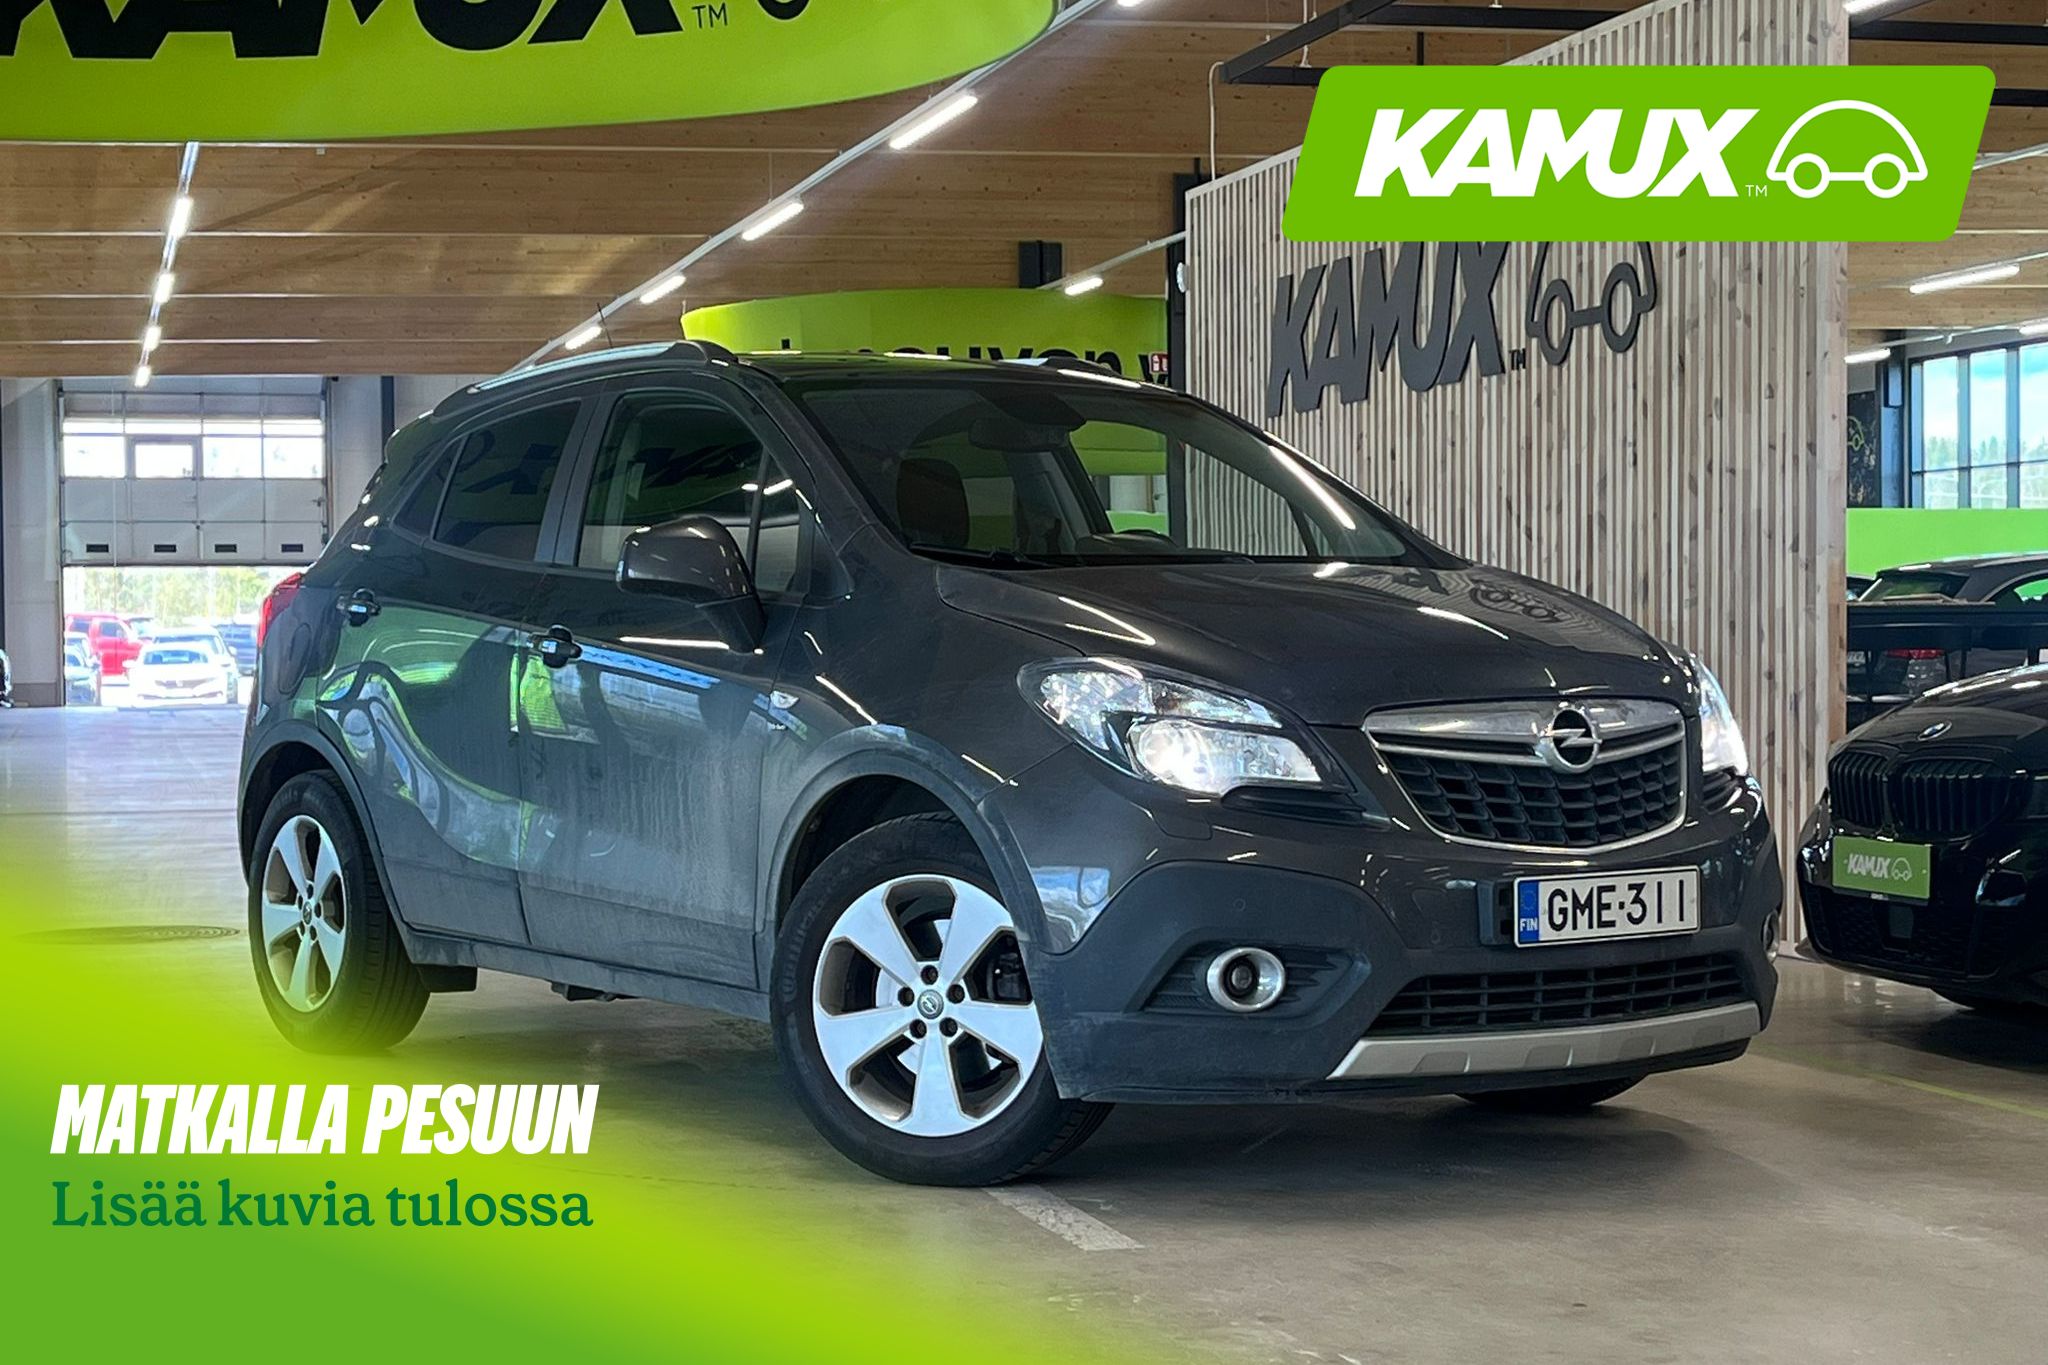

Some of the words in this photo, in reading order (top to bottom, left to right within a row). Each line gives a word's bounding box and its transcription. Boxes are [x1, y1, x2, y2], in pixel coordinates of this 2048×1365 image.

[691, 2, 728, 29] TM
[1268, 241, 1508, 418] KAMUX
[1508, 348, 1527, 371] TM
[1847, 852, 1891, 879] KAMUX
[1519, 917, 1538, 932] FIN
